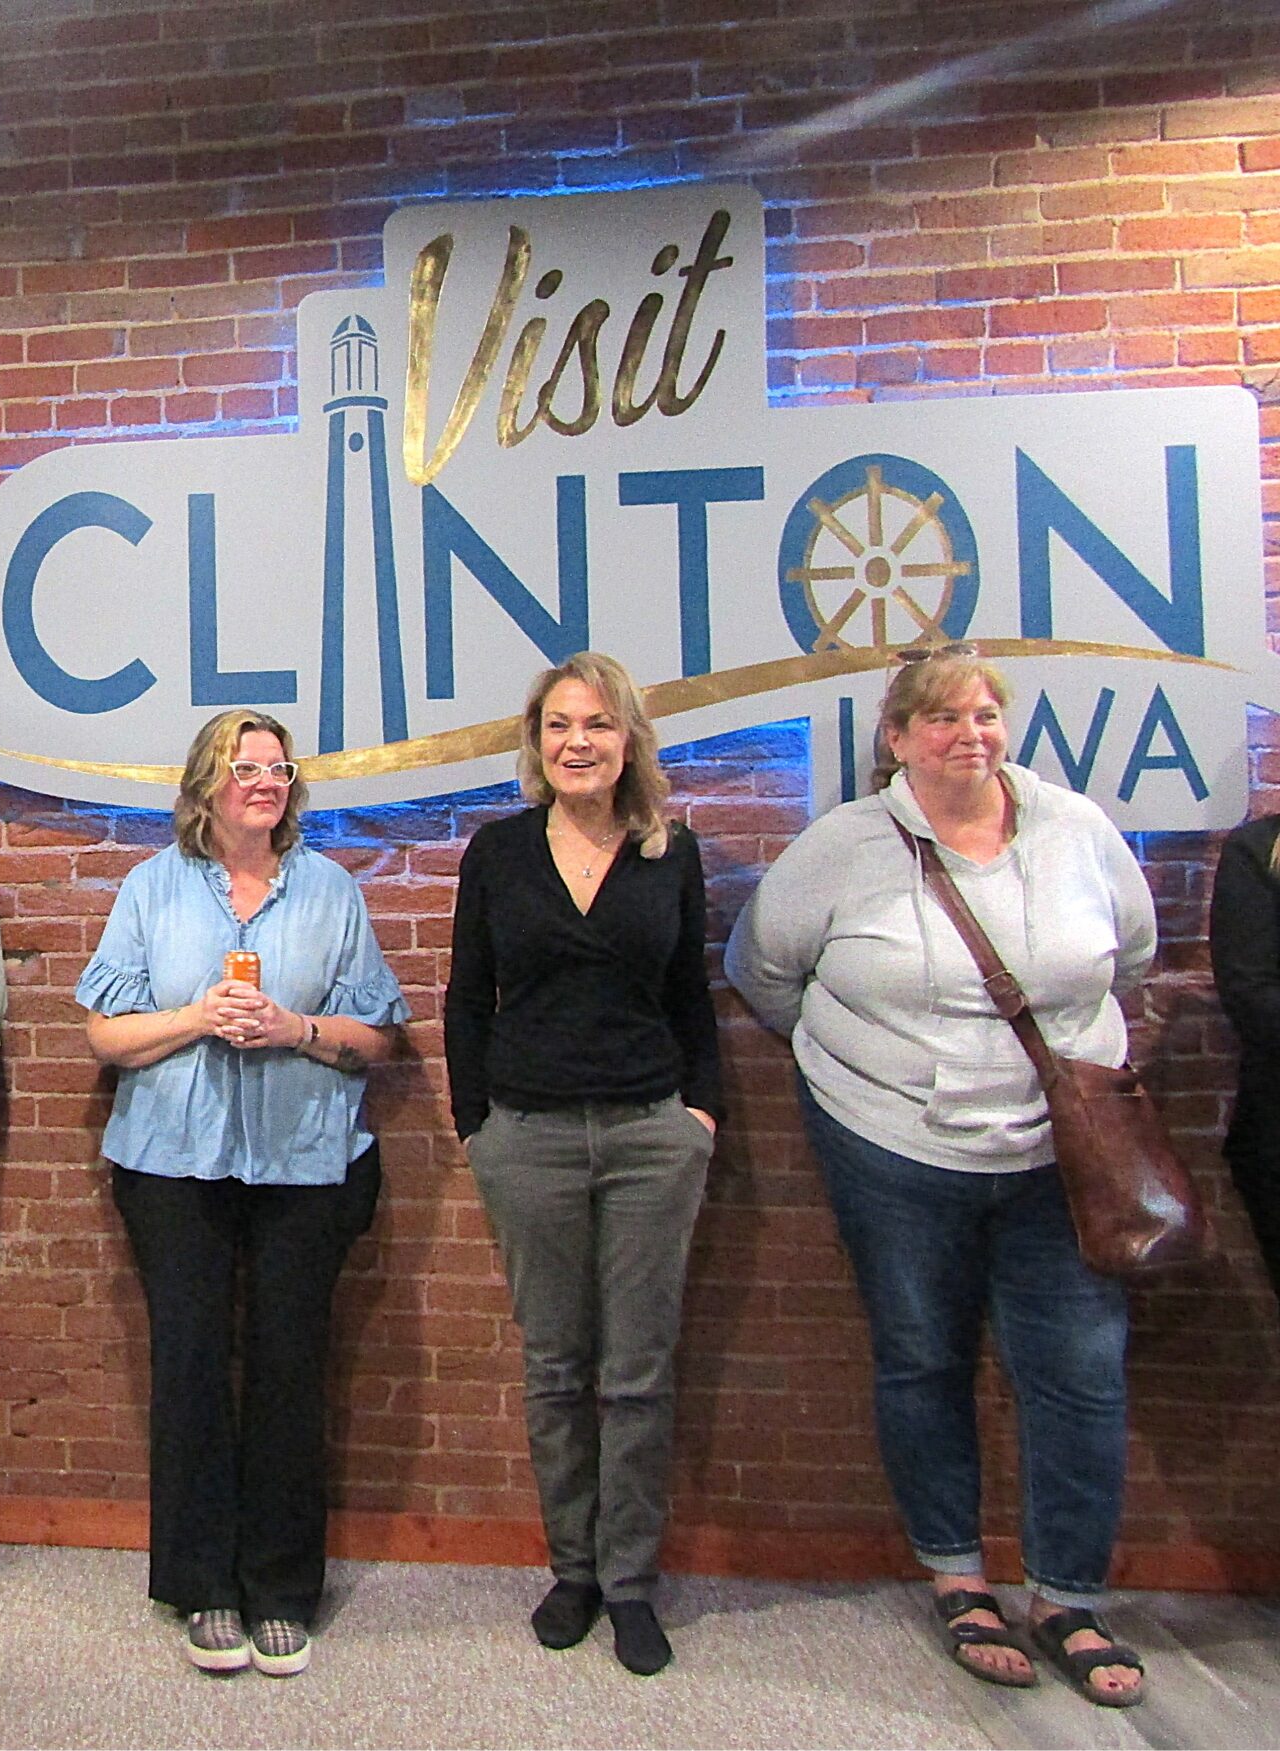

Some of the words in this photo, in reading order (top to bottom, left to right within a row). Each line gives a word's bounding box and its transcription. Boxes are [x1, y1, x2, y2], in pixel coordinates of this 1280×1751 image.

[403, 208, 733, 487] Visit
[2, 314, 1205, 754] CLINTON
[839, 683, 1210, 802] IWA
